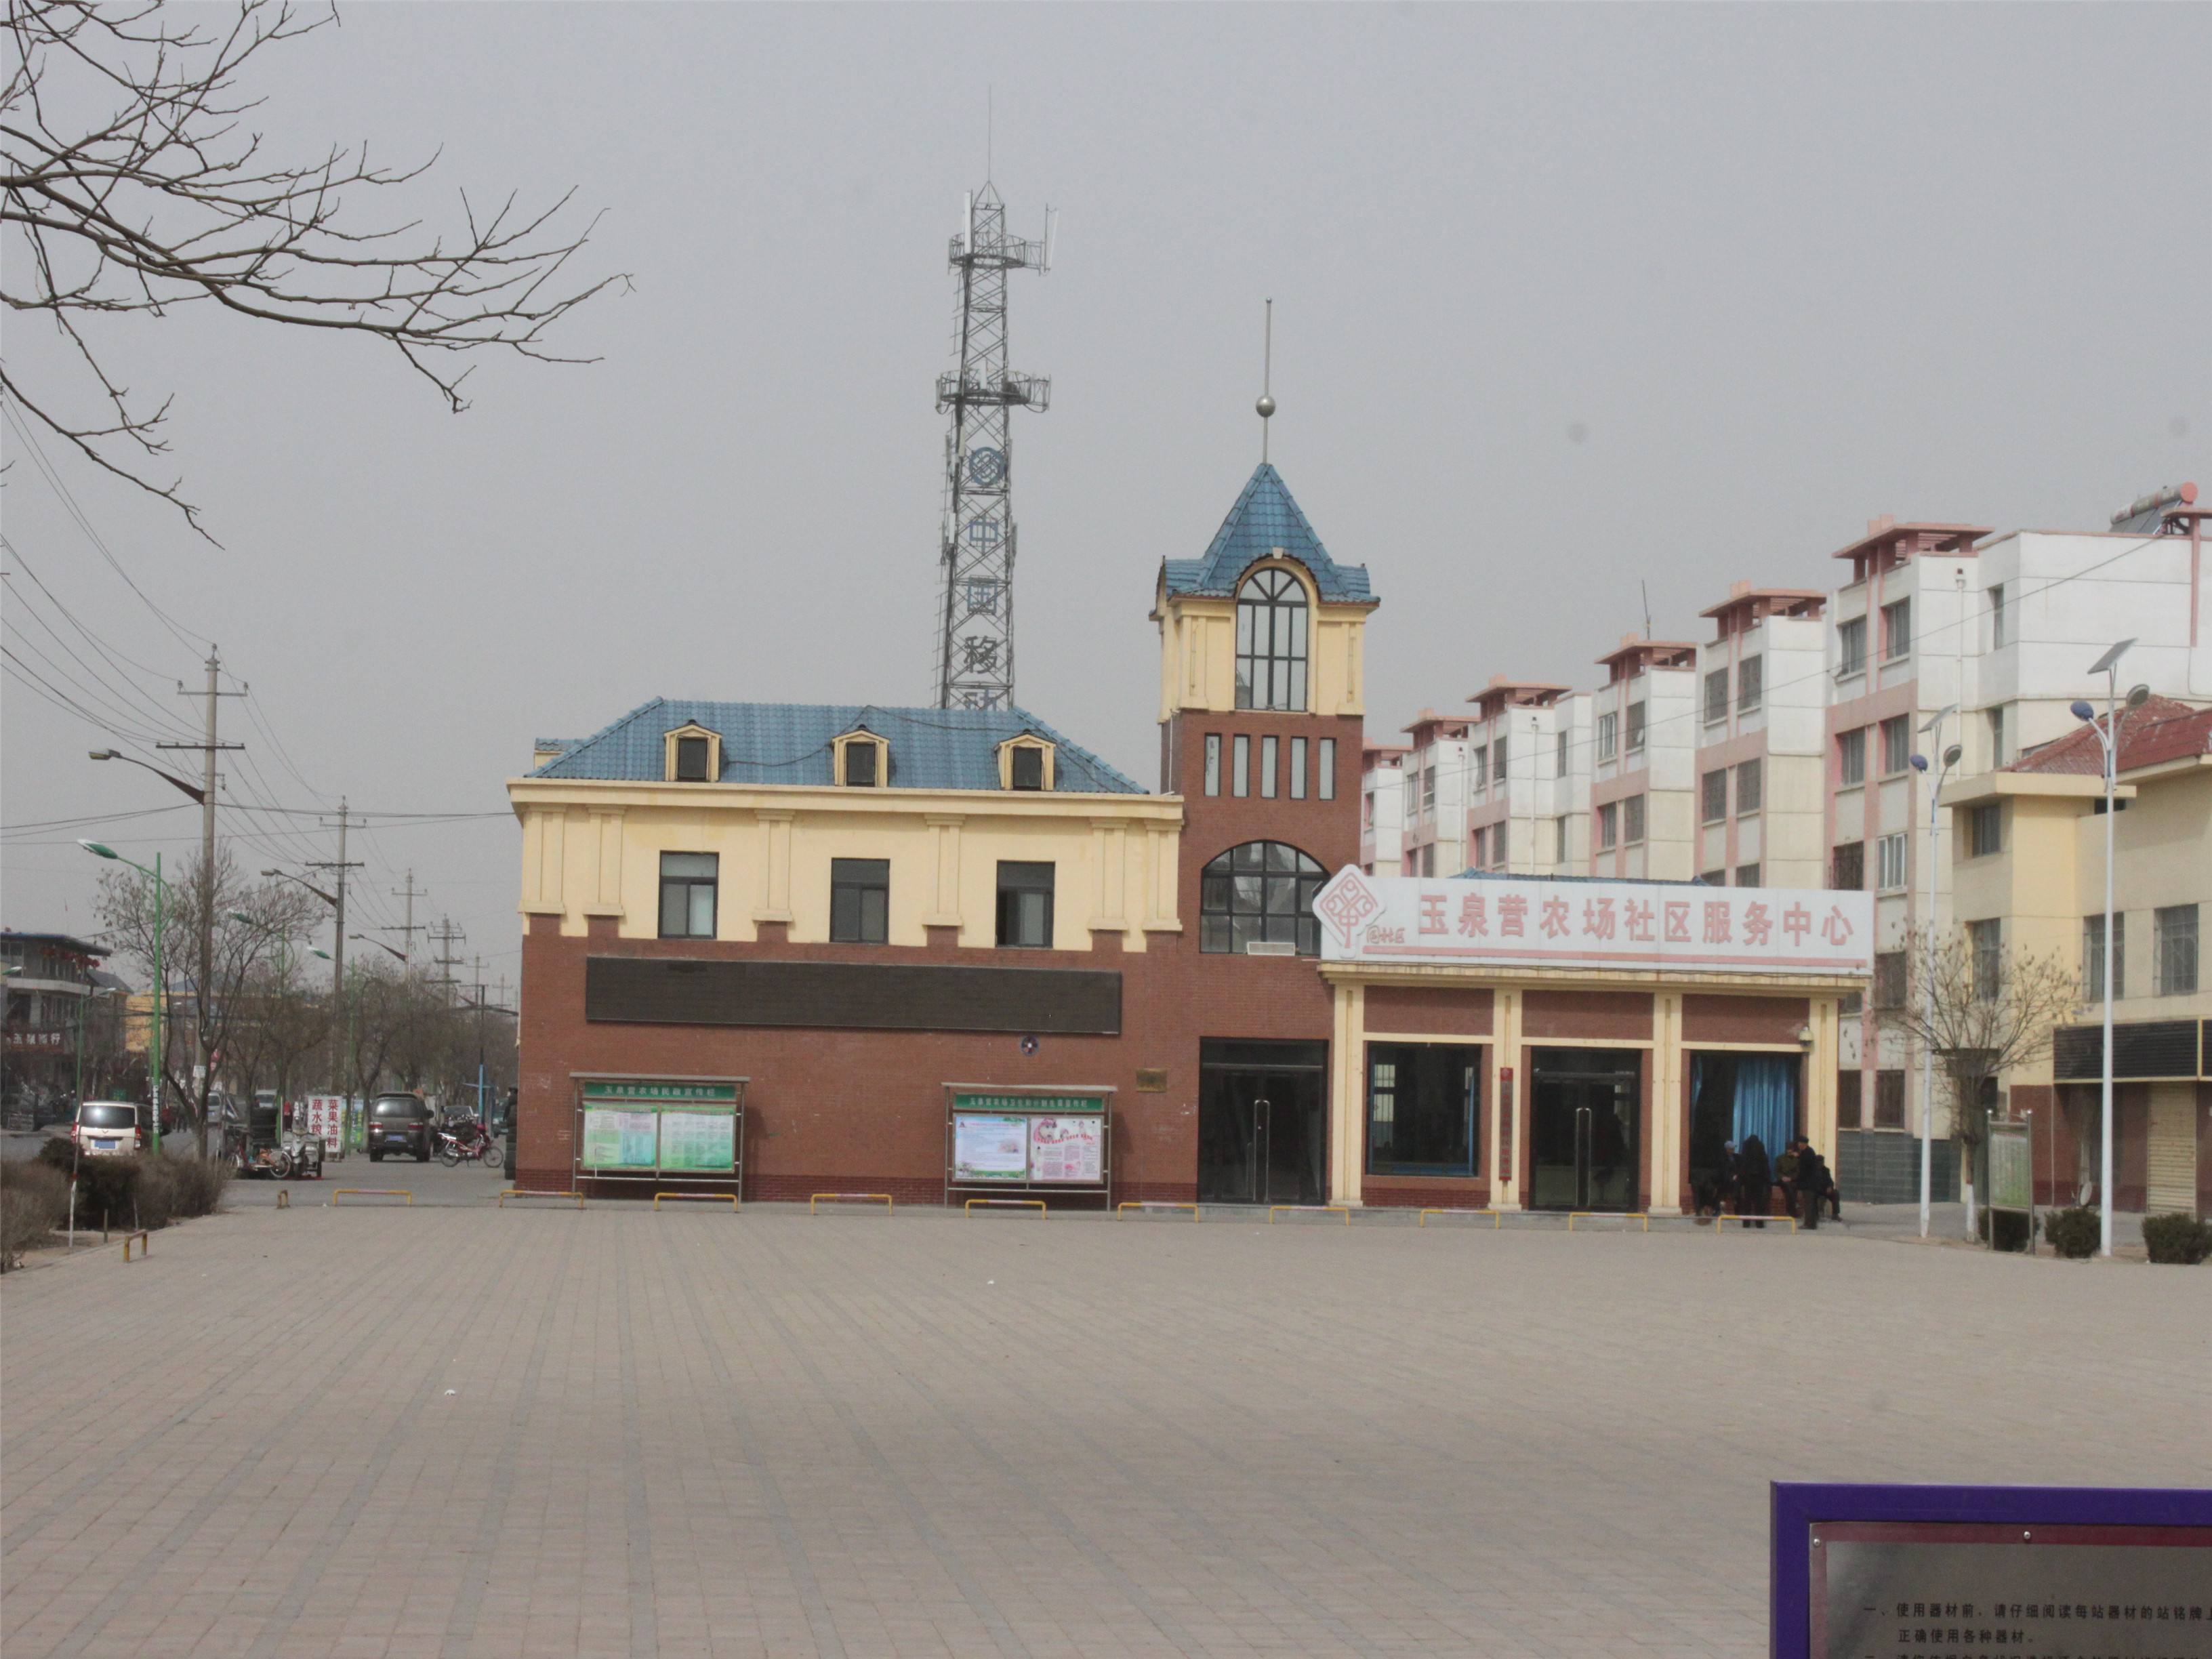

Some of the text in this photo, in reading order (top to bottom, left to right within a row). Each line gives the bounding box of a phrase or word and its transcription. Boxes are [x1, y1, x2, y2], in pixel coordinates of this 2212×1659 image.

[1418, 893, 1854, 947] 玉泉营农场社区服务中心
[1898, 1629, 2034, 1643] 正确使用各种器材。
